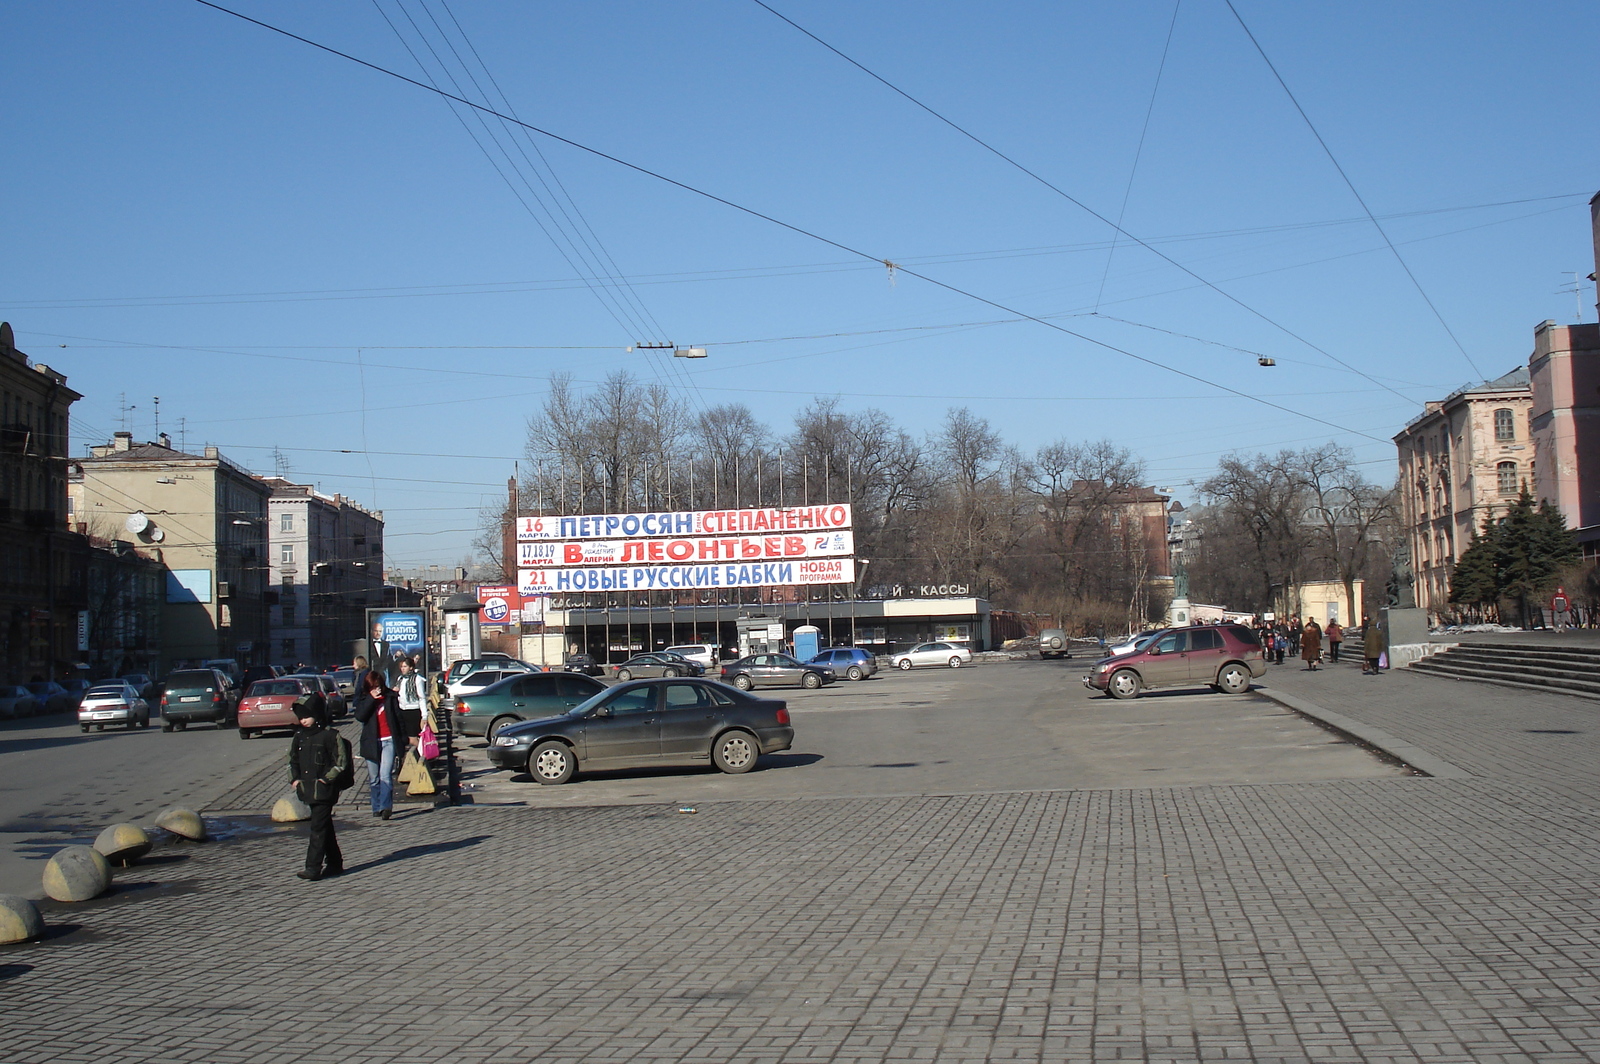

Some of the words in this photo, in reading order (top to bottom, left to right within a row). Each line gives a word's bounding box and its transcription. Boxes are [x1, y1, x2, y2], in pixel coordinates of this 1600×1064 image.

[526, 519, 543, 532] 16
[560, 513, 693, 537] ПЕТРОСЯН
[702, 505, 846, 533] СТЕПАНЕНКО
[620, 536, 807, 562] ЛЕОНТЬЕВ
[800, 561, 842, 573] НОВАЯ
[529, 571, 547, 585] 21
[557, 569, 628, 590] НОВЫЕ
[633, 566, 720, 588] РУССКИЕ
[726, 563, 792, 585] БАБКИ
[800, 573, 842, 582] ПРОГРАММА
[920, 584, 970, 596] КАССЫ
[385, 626, 417, 634] ПЛАТИТЬ
[385, 633, 418, 642] ДОРОГО?
